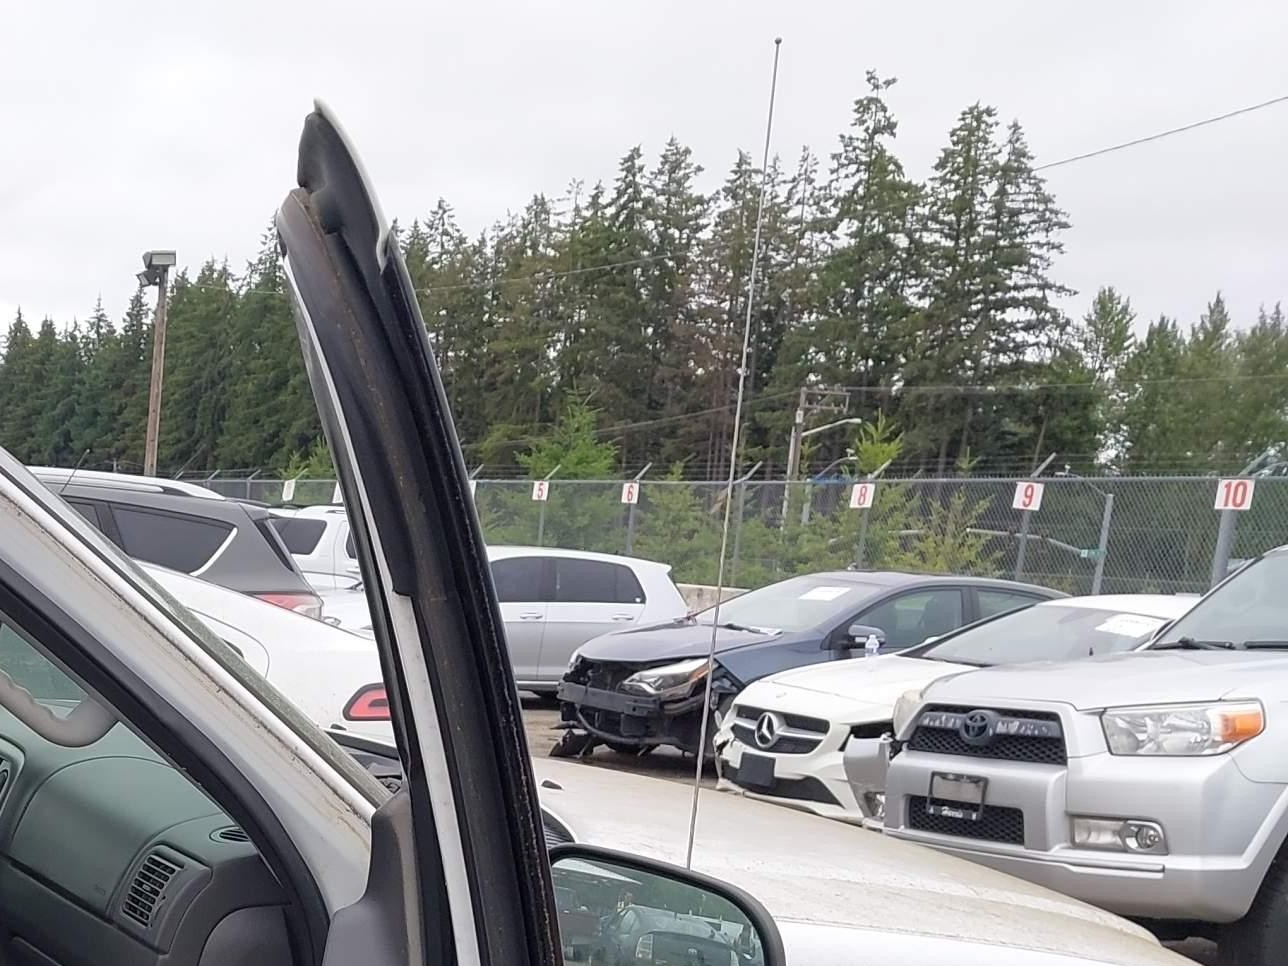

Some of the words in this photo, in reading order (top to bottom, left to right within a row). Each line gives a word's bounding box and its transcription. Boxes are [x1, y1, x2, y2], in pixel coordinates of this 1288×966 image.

[537, 482, 544, 498] 5
[627, 484, 634, 501] 6
[858, 485, 867, 506] 8
[1022, 484, 1034, 507] 9
[1224, 480, 1248, 507] 10
